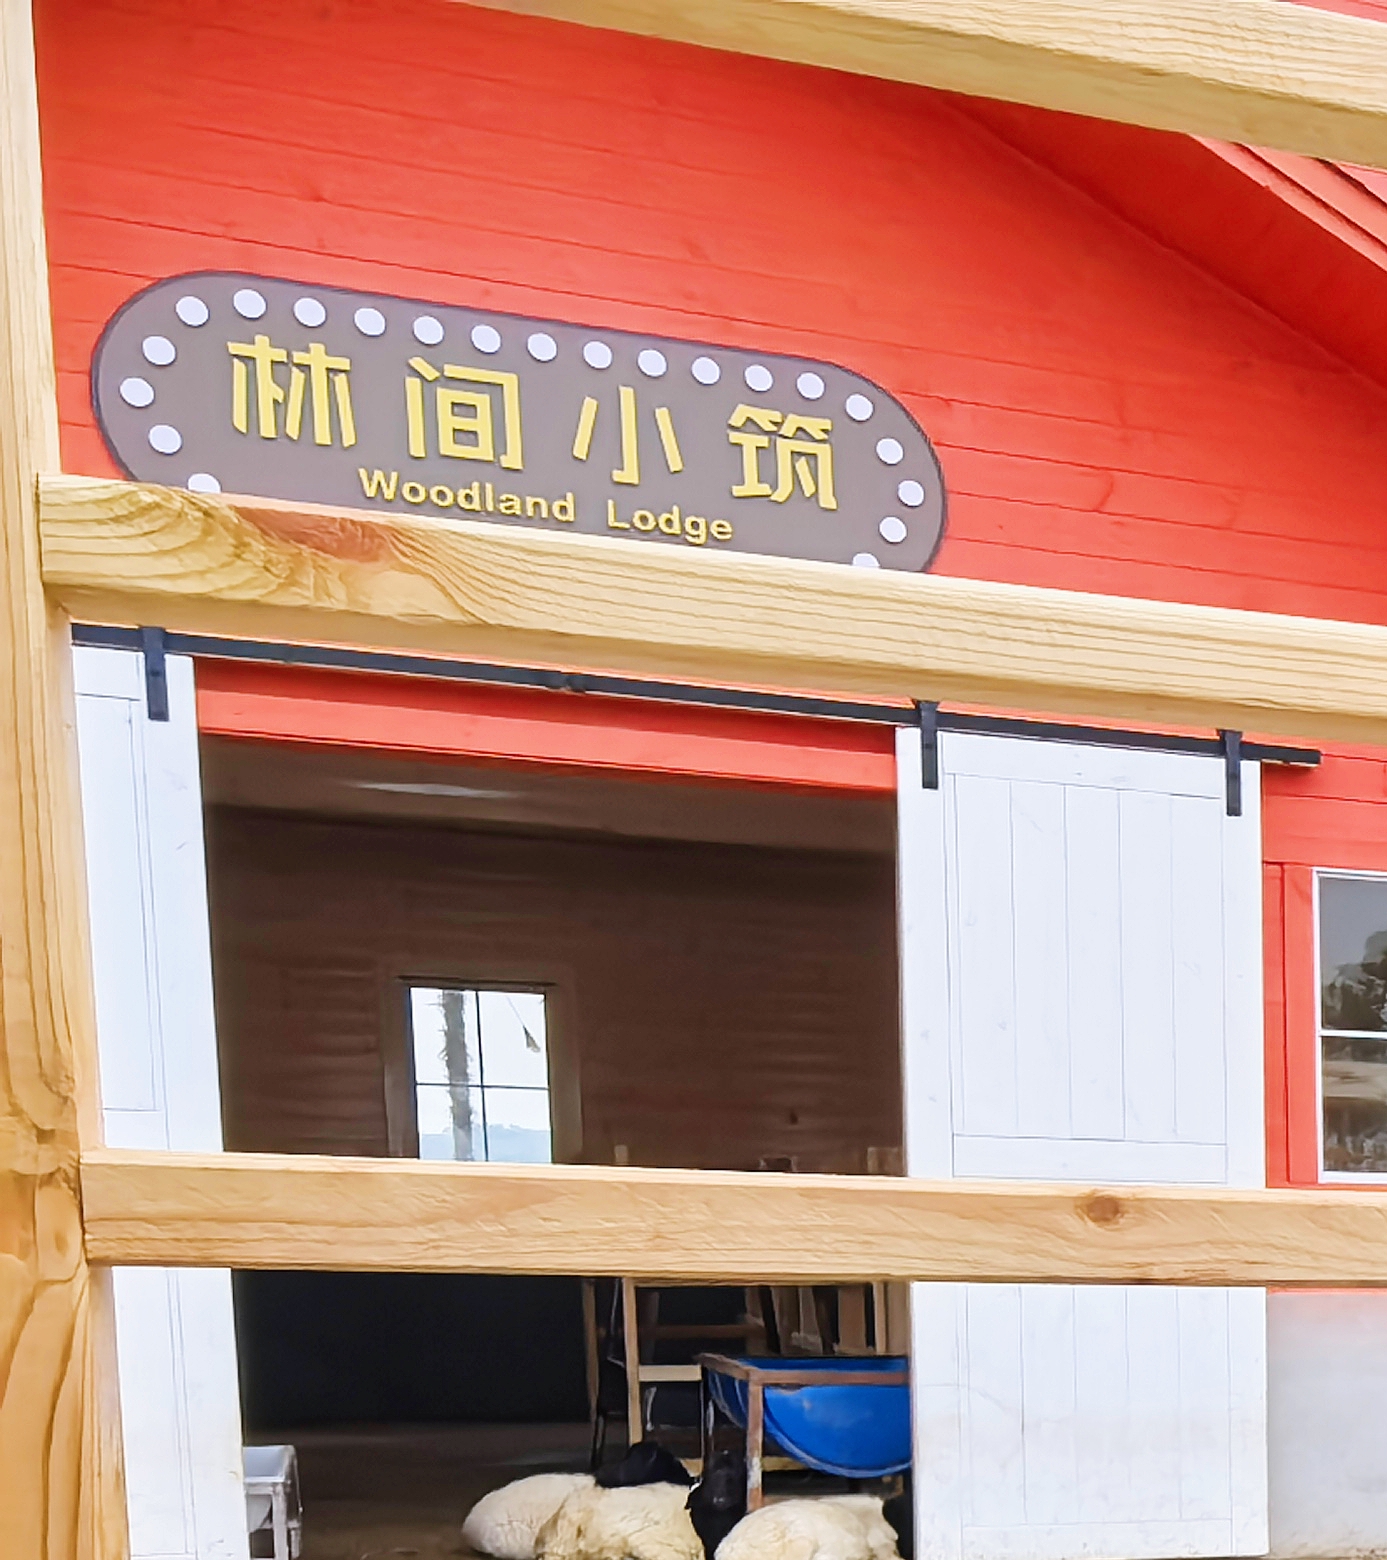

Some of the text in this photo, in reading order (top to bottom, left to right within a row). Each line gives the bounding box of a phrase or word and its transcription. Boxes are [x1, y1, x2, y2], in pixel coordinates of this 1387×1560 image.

[227, 333, 839, 510] 林间小筑
[358, 469, 734, 544] Woodland Lodge
